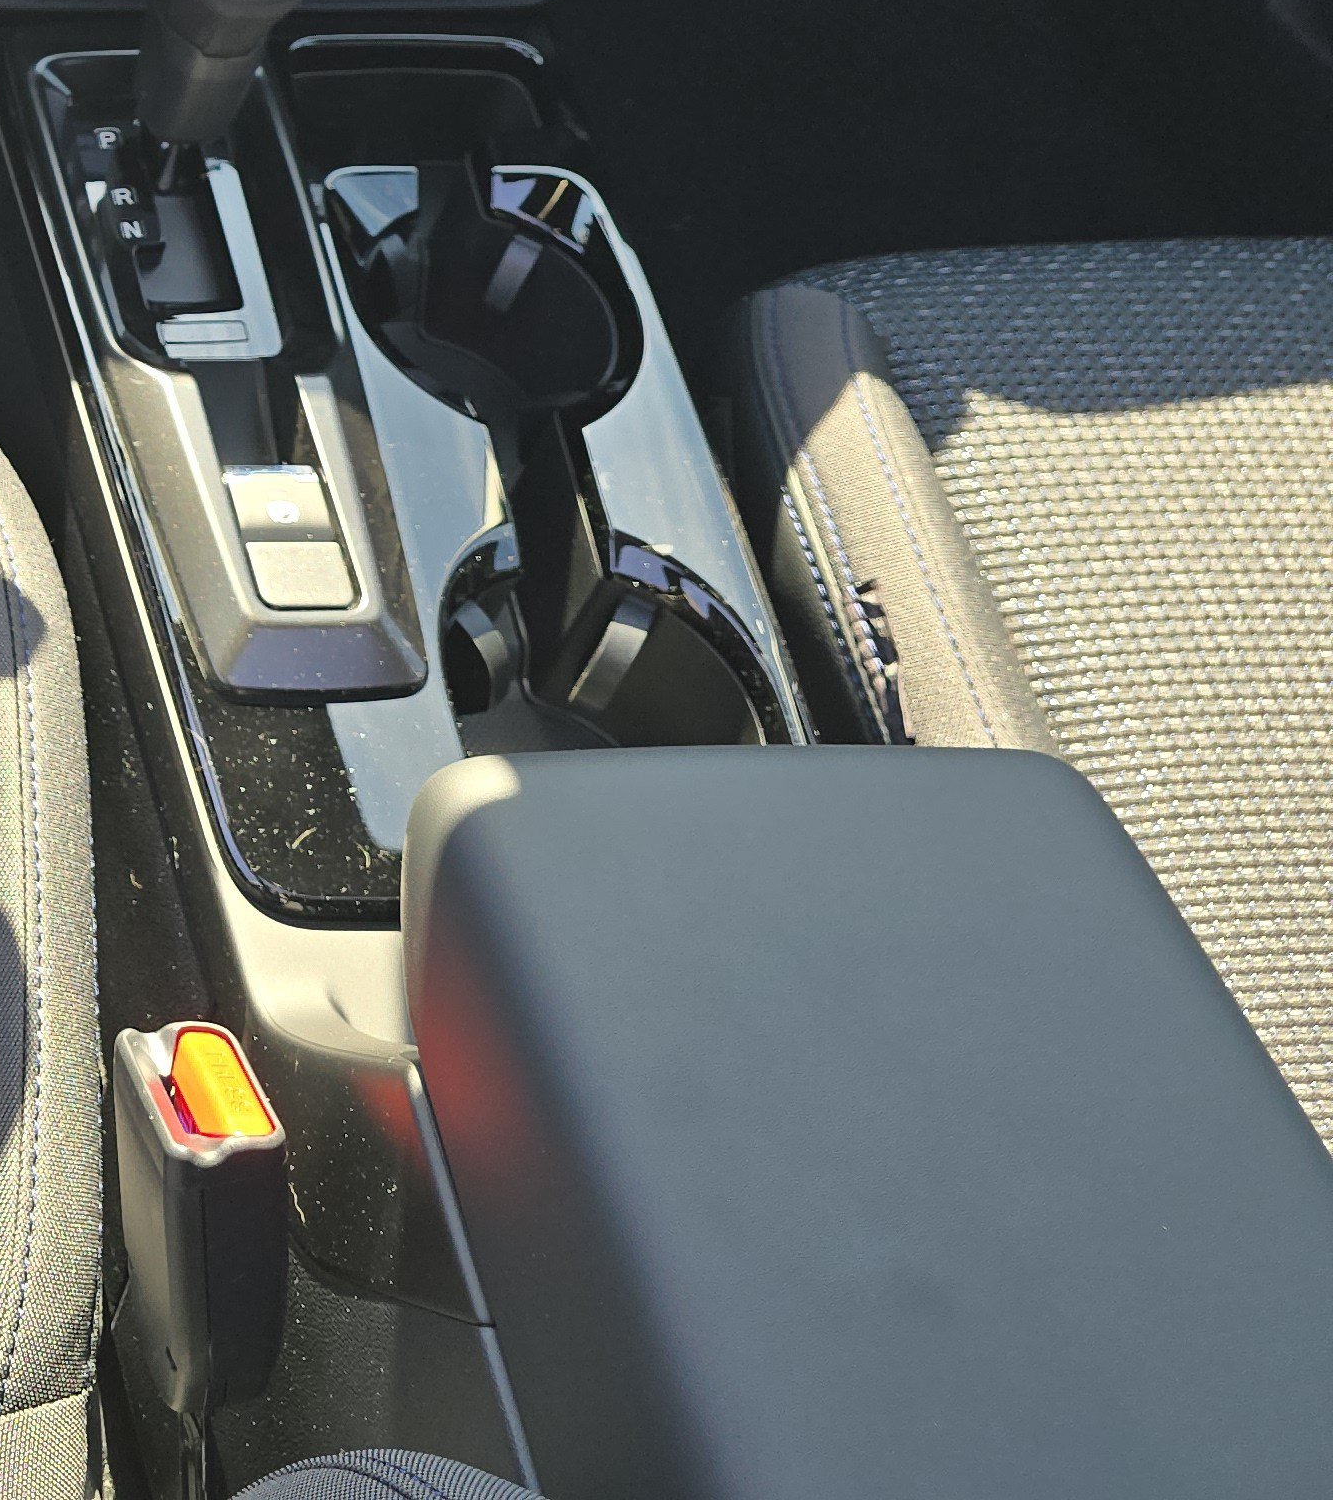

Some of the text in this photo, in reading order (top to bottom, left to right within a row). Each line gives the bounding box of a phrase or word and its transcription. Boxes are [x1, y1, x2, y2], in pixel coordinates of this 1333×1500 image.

[99, 130, 117, 150] P
[111, 186, 135, 206] R
[119, 220, 144, 240] N
